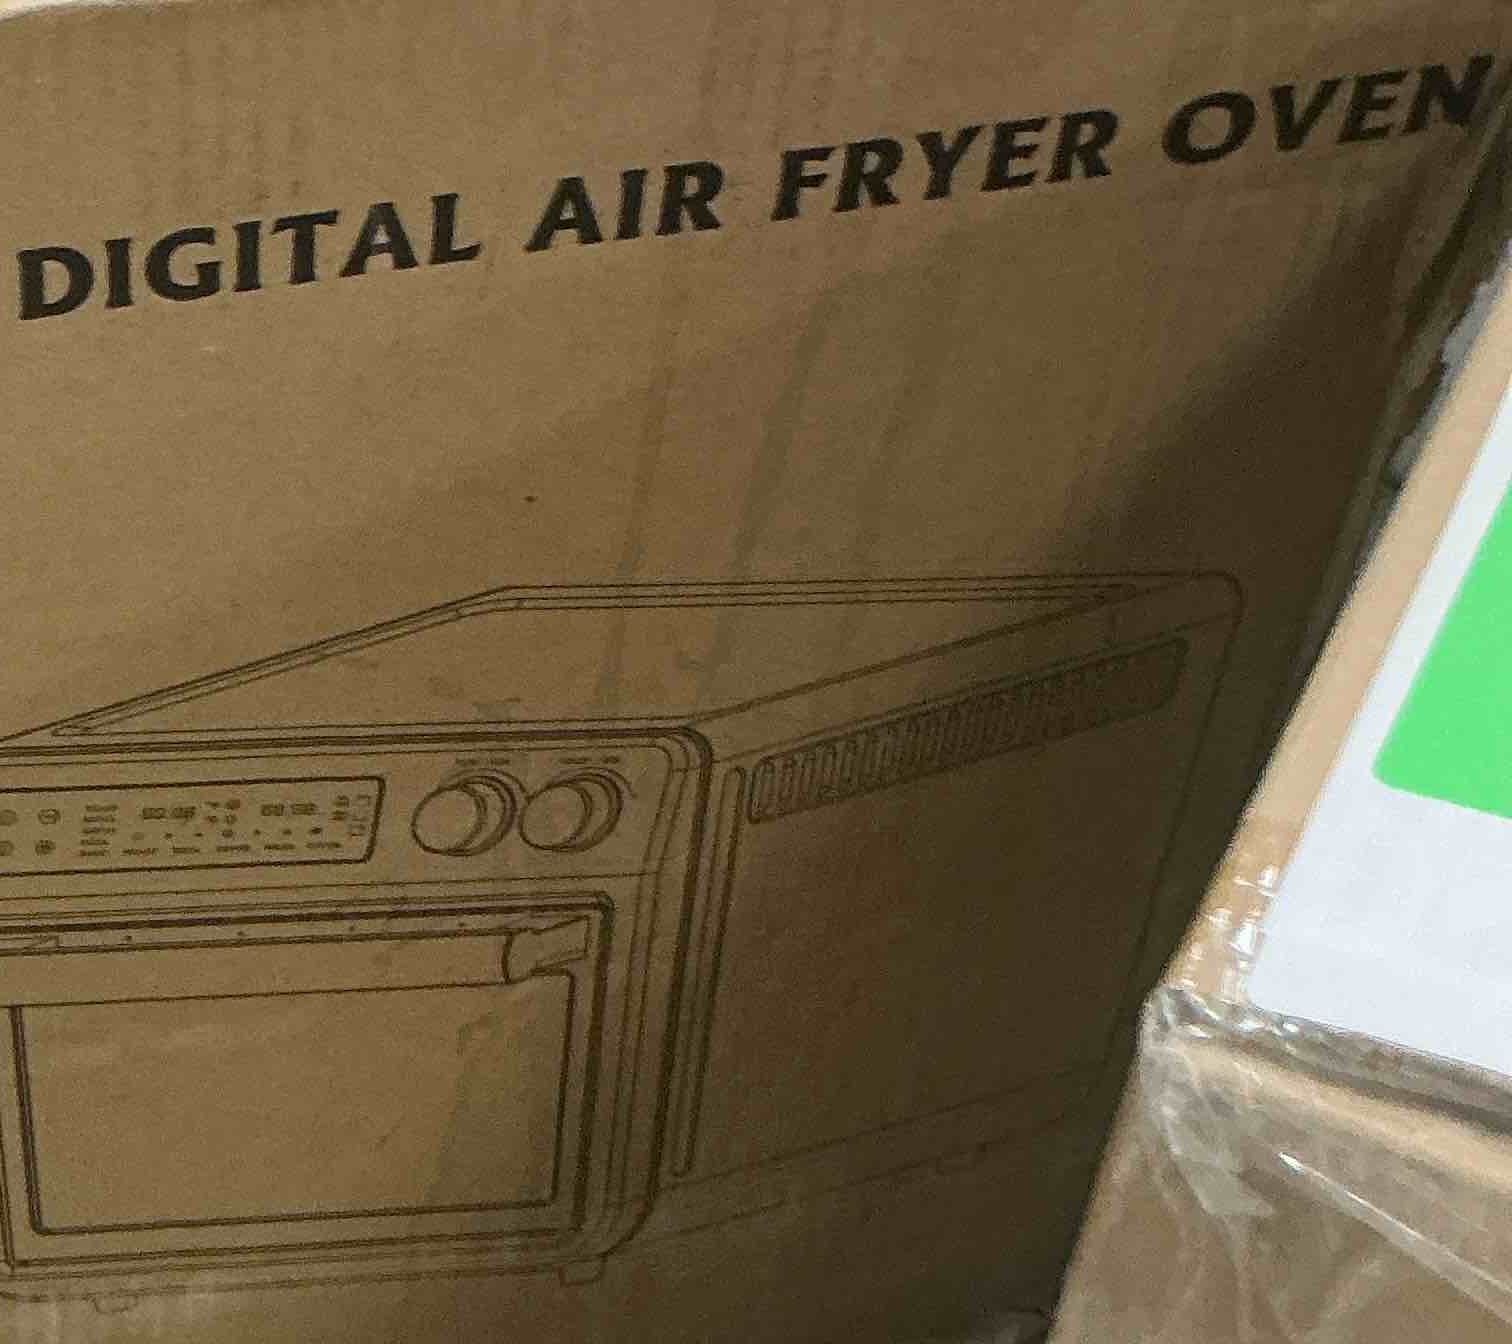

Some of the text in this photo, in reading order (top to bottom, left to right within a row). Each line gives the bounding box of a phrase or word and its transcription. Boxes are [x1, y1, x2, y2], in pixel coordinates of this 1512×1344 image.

[17, 52, 1494, 322] DIGITAL AIR FRYER OVEN
